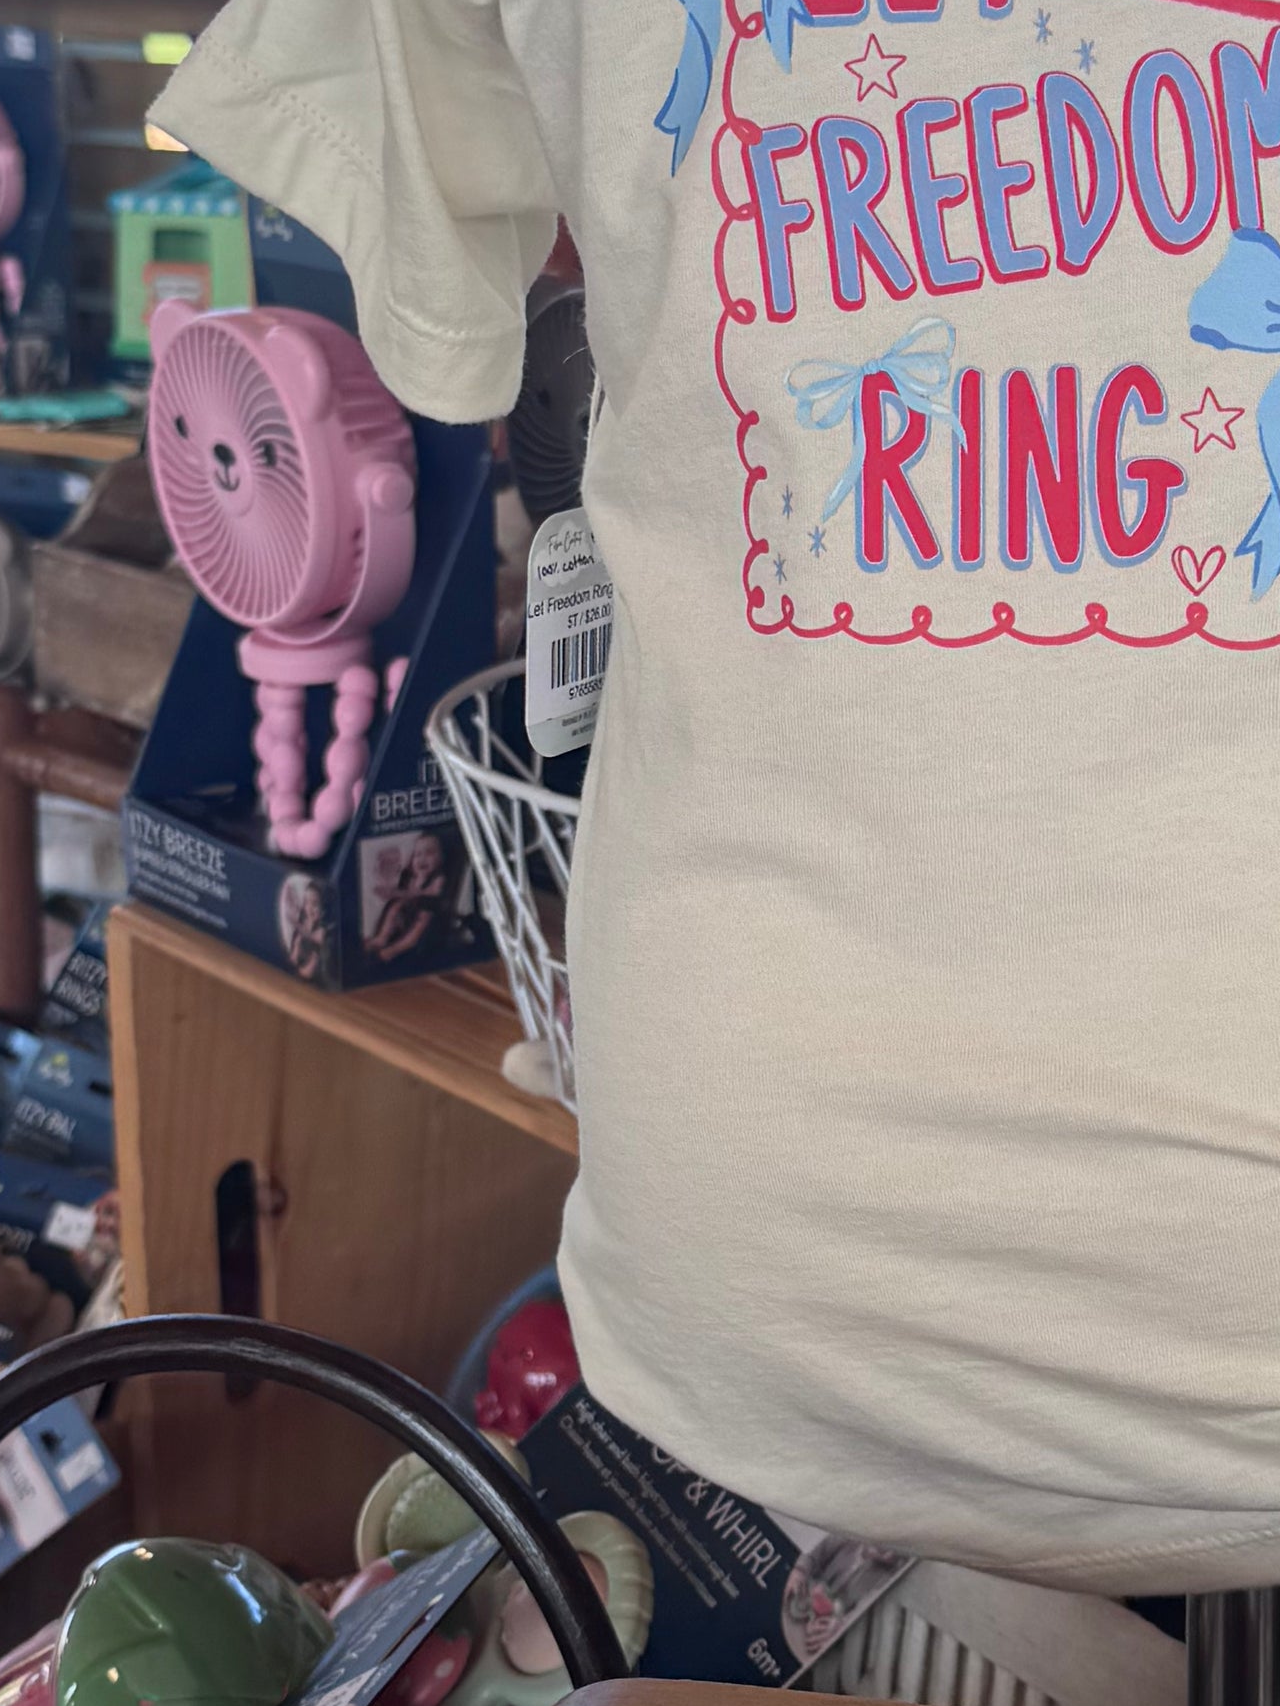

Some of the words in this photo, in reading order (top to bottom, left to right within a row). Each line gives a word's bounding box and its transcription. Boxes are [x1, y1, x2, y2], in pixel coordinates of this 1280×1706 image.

[852, 363, 1189, 573] RING
[528, 599, 545, 619] Let
[547, 587, 592, 614] Freedom
[593, 582, 613, 600] Ring
[371, 785, 456, 821] BREEZ
[161, 821, 228, 881] BREEZE
[705, 1489, 783, 1590] WHIRL
[746, 1637, 782, 1678] 6m+
